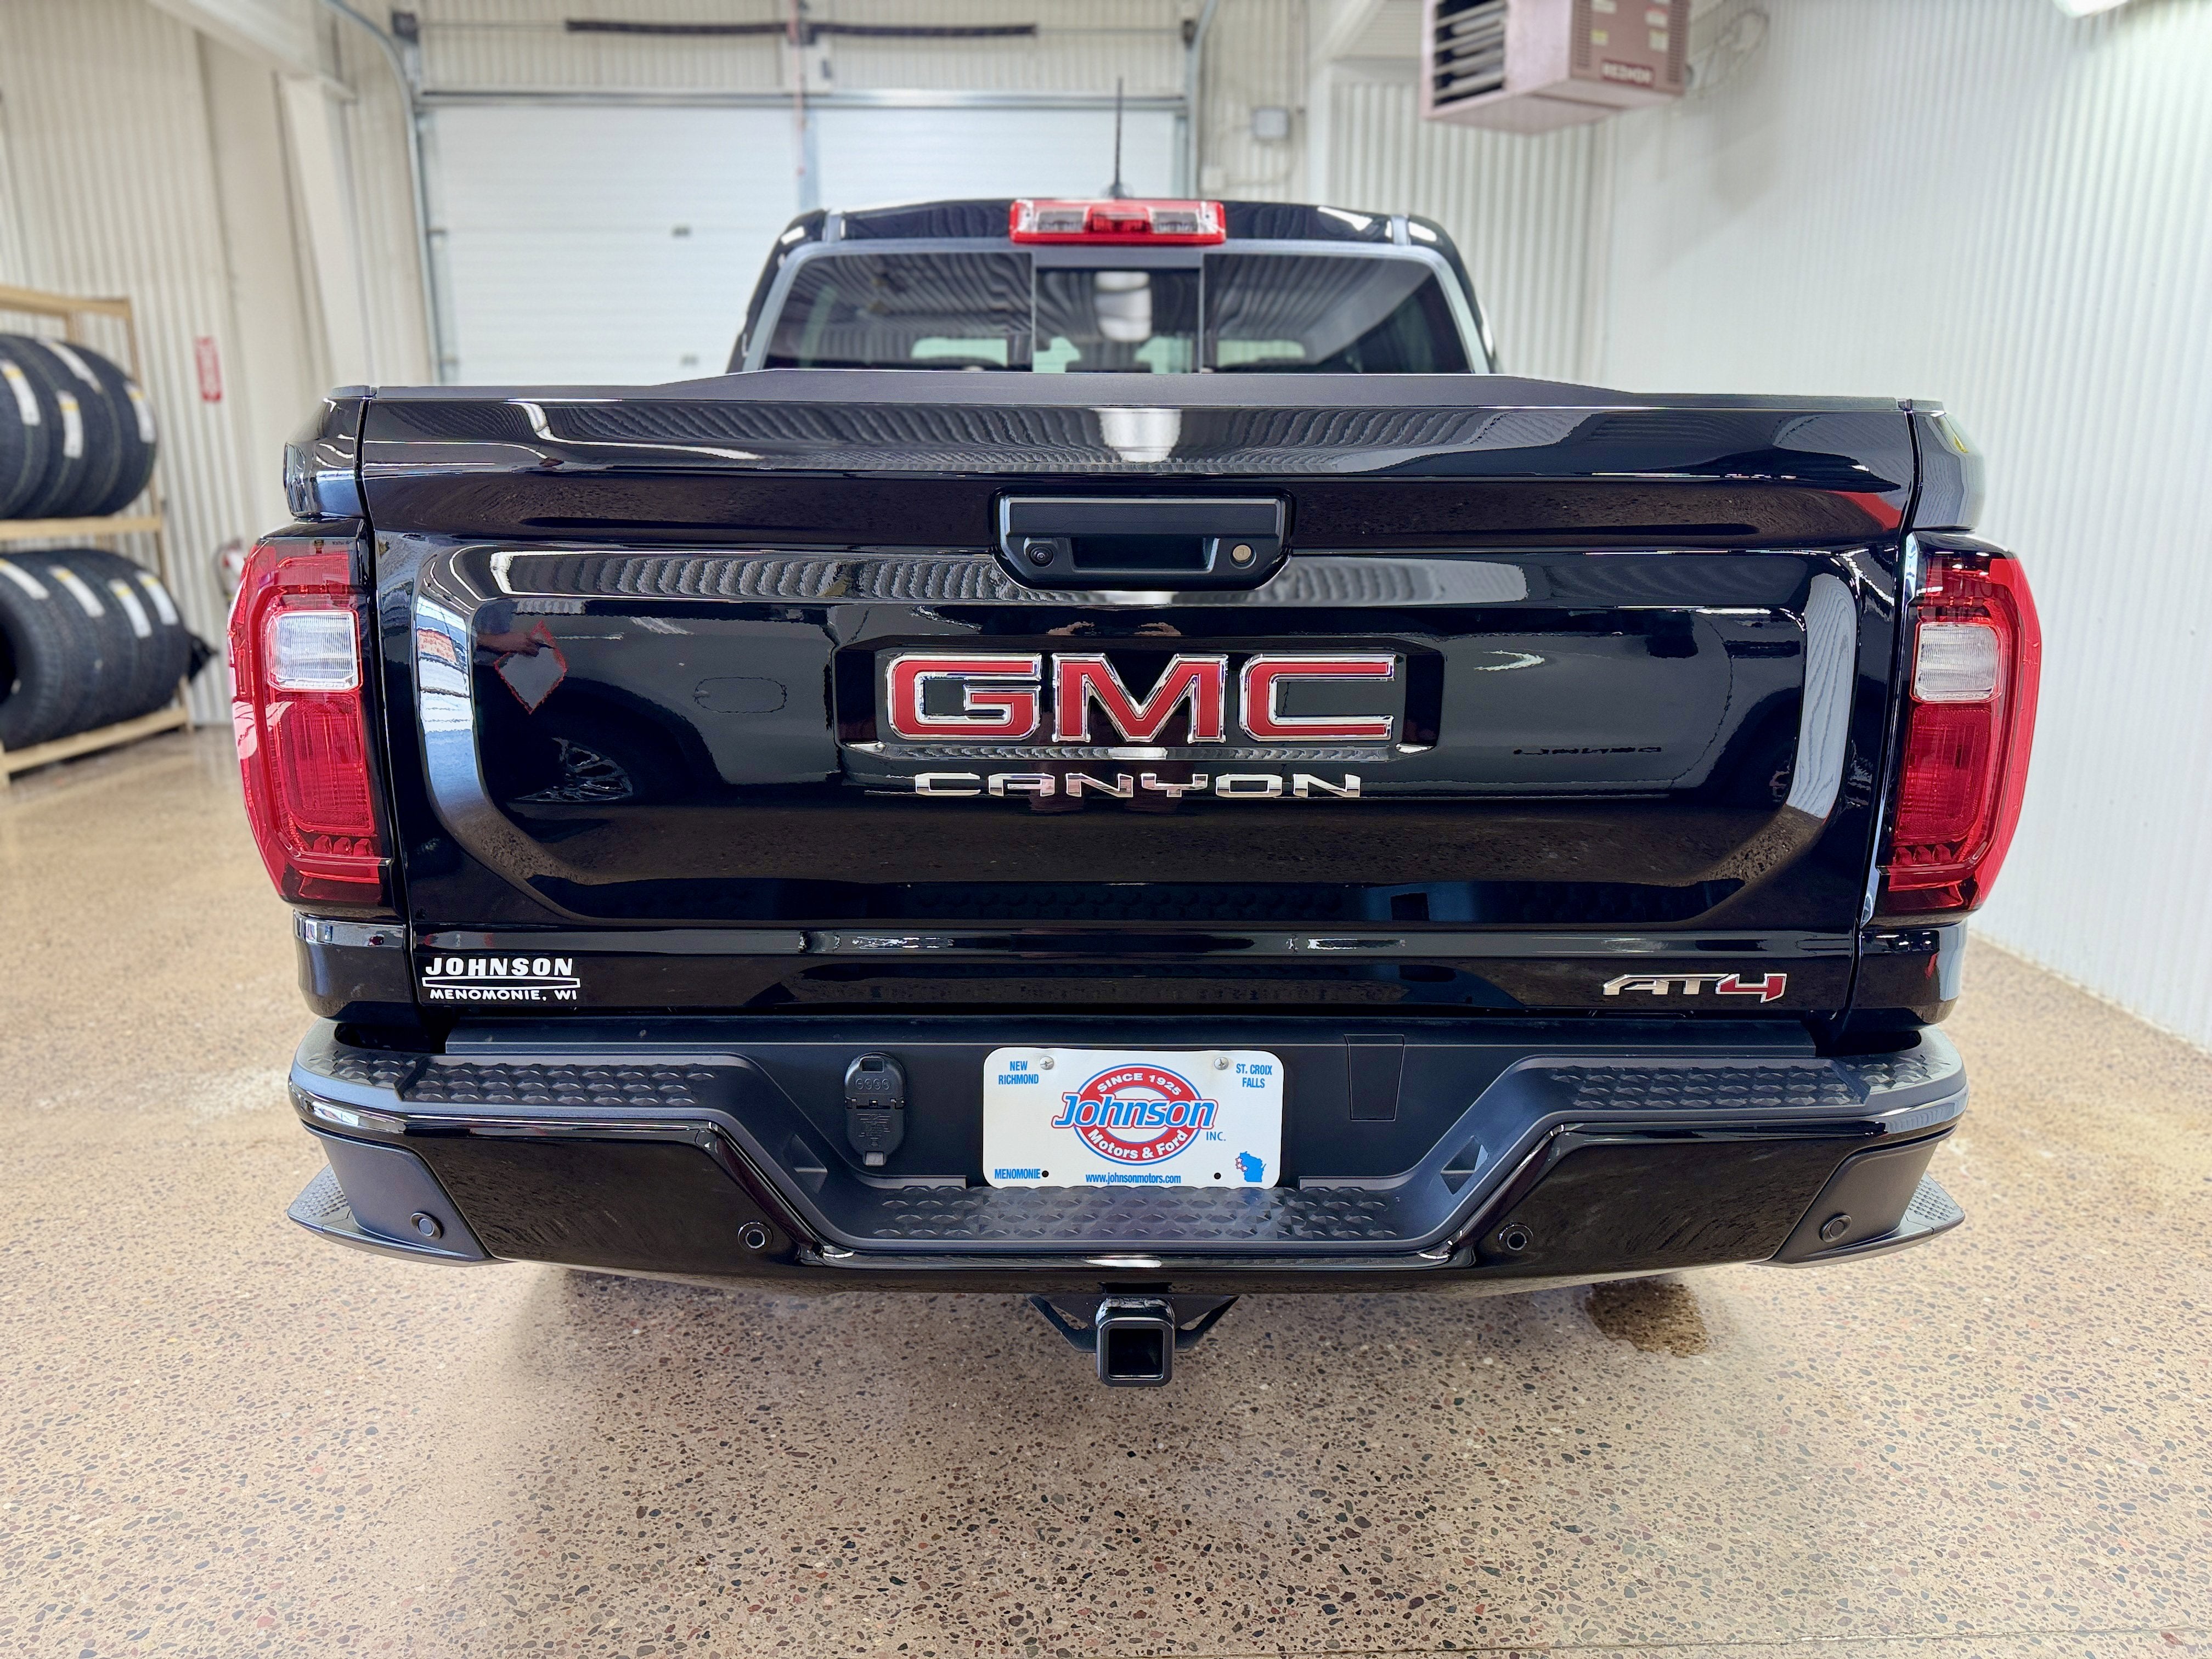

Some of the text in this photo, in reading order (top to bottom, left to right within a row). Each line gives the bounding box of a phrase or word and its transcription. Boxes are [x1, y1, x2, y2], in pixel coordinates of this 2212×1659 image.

[887, 652, 1397, 744] GMC
[914, 772, 1362, 798] CANYON
[425, 957, 573, 976] JOHNSON
[1602, 973, 1787, 1003] AT4
[430, 989, 577, 1001] MENOMONIE, WI
[1009, 1060, 1028, 1071] NEW
[1235, 1063, 1272, 1075] ST. CROIX
[998, 1074, 1039, 1085] RICHMOND
[1097, 1073, 1182, 1096] SINCE 1925
[1242, 1077, 1265, 1088] FALLS
[1054, 1095, 1214, 1127] Johnson
[1206, 1131, 1226, 1142] INC.
[1087, 1129, 1188, 1160] Motors & Ford
[994, 1169, 1041, 1180] MENOMONIE
[1086, 1172, 1181, 1184] www.johnsonmotors.com
